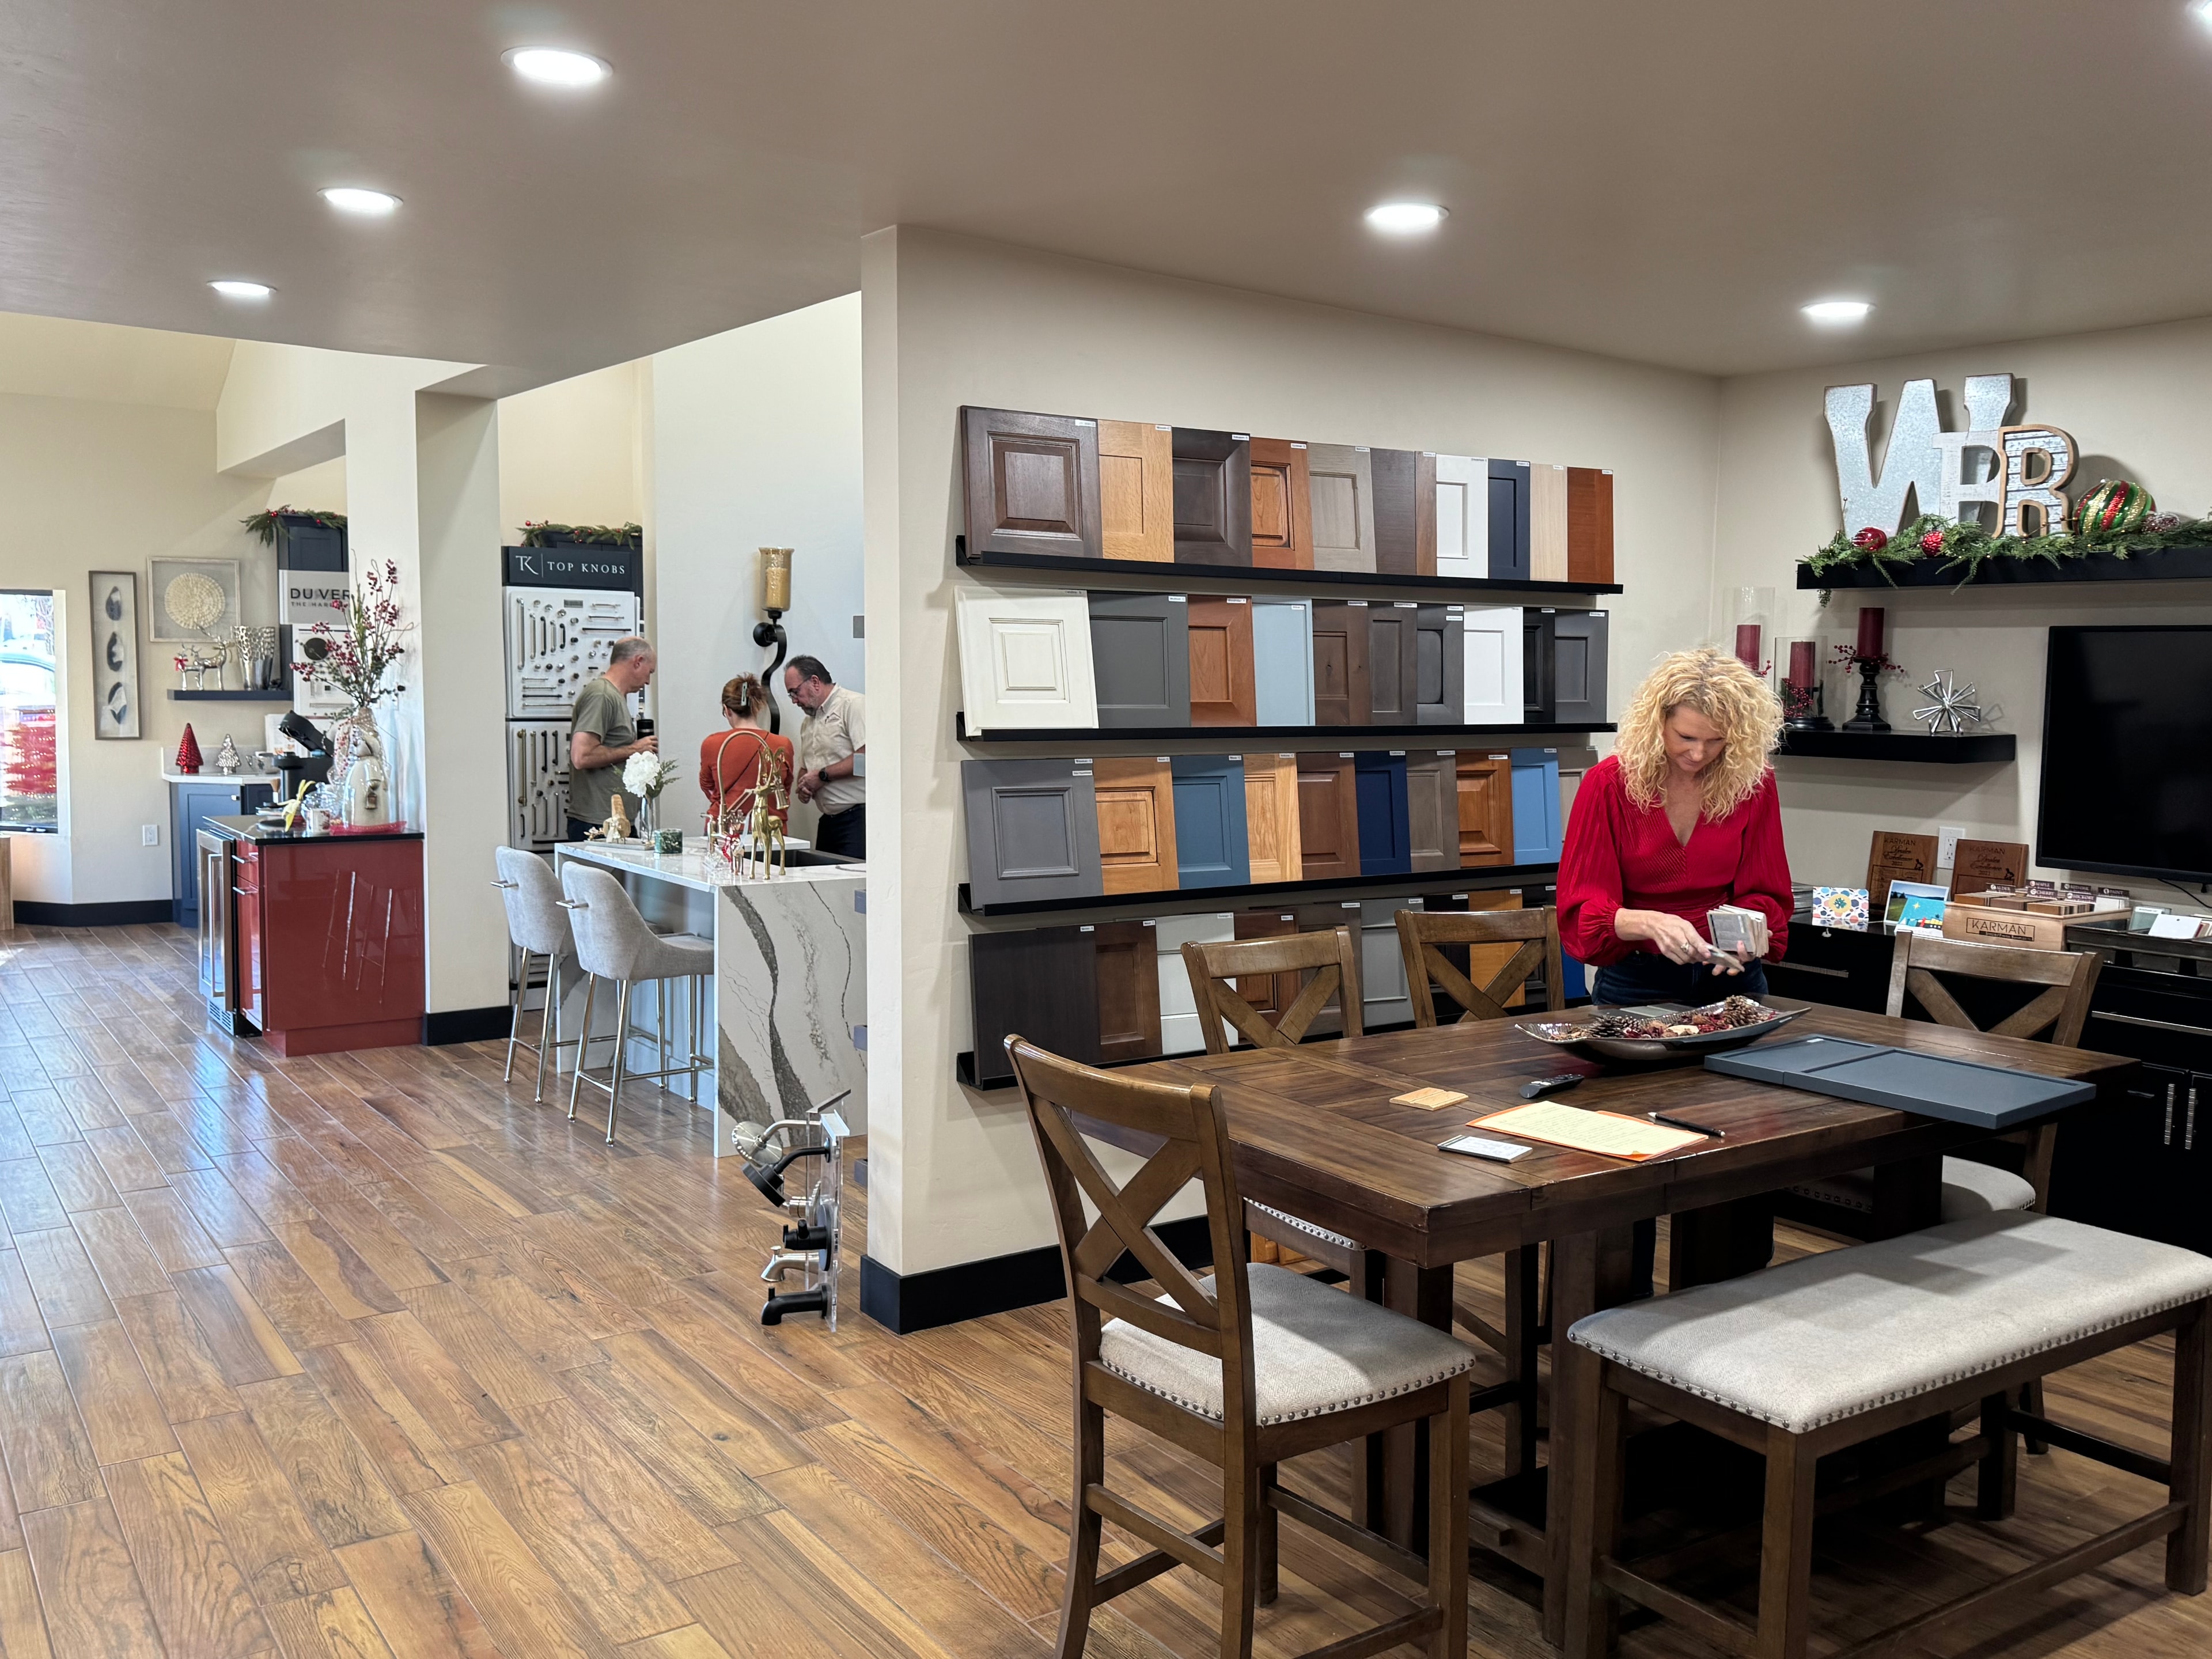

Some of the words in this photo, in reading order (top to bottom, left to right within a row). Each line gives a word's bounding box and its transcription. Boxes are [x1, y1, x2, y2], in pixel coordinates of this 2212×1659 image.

[547, 562, 574, 571] TOP
[581, 563, 625, 574] KNOBS
[1884, 837, 1916, 846] KARMAN
[1970, 846, 2005, 855] KARMAN
[1972, 919, 2026, 935] KARMAN
